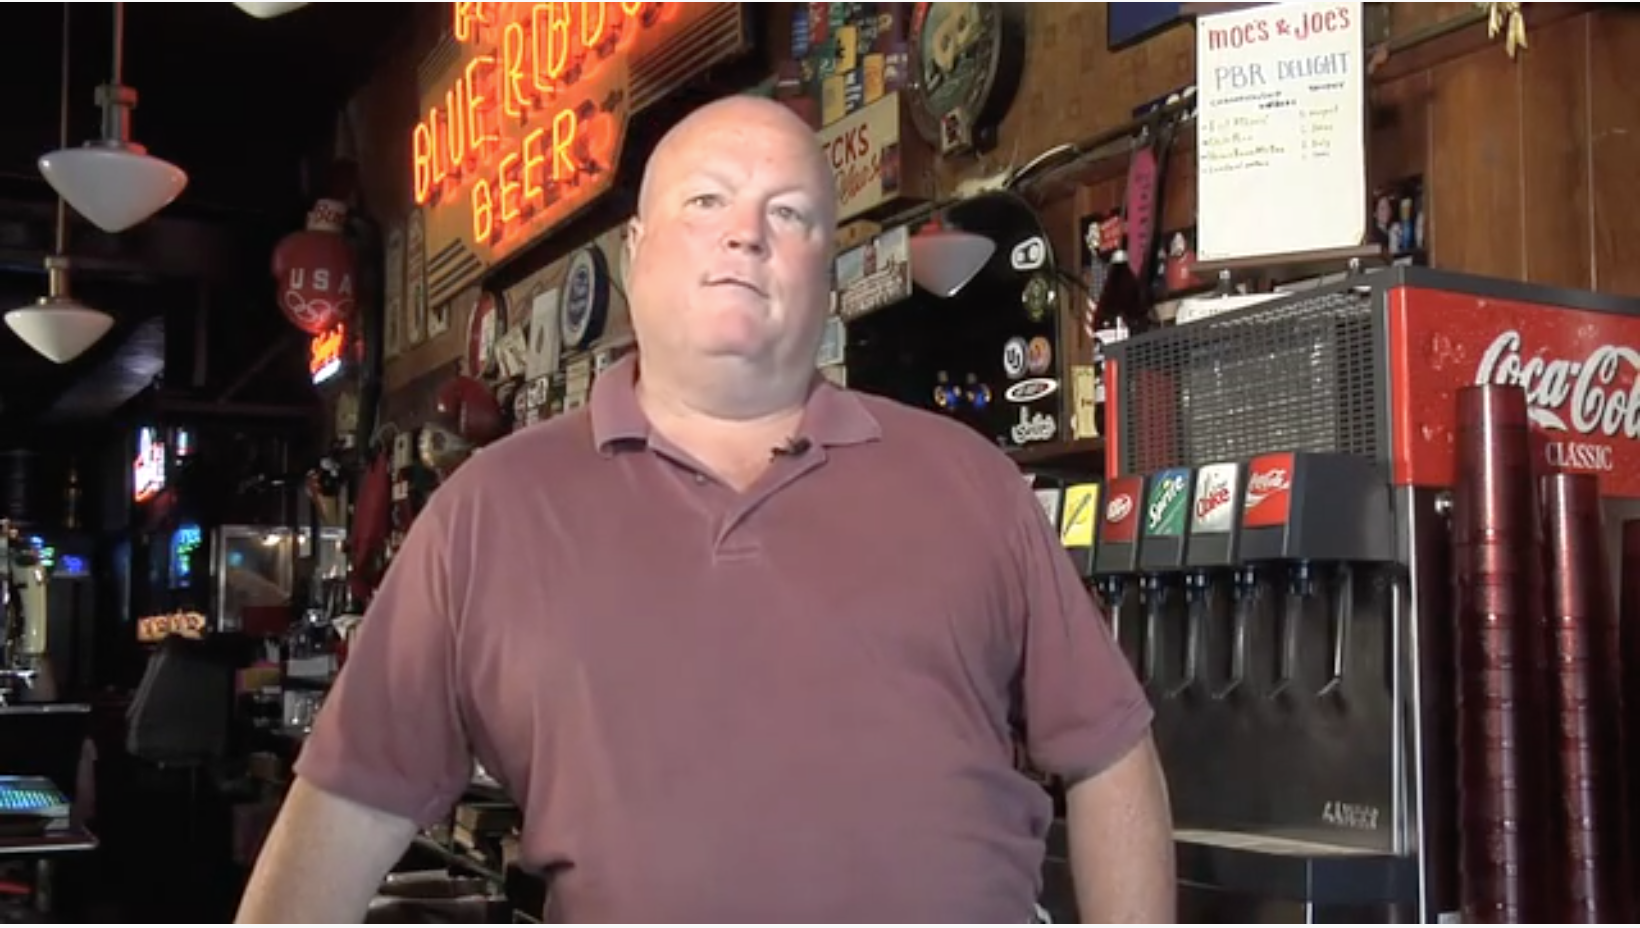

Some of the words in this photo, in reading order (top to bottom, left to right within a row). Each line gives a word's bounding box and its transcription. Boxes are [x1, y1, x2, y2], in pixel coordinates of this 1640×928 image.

[1275, 17, 1291, 36] &
[1214, 62, 1267, 91] PBR
[1277, 51, 1350, 81] DELIGHT
[413, 56, 498, 204] BLUE
[471, 109, 577, 243] BEER
[1545, 441, 1613, 471] CLASSIC
[1149, 474, 1184, 529] Sprite
